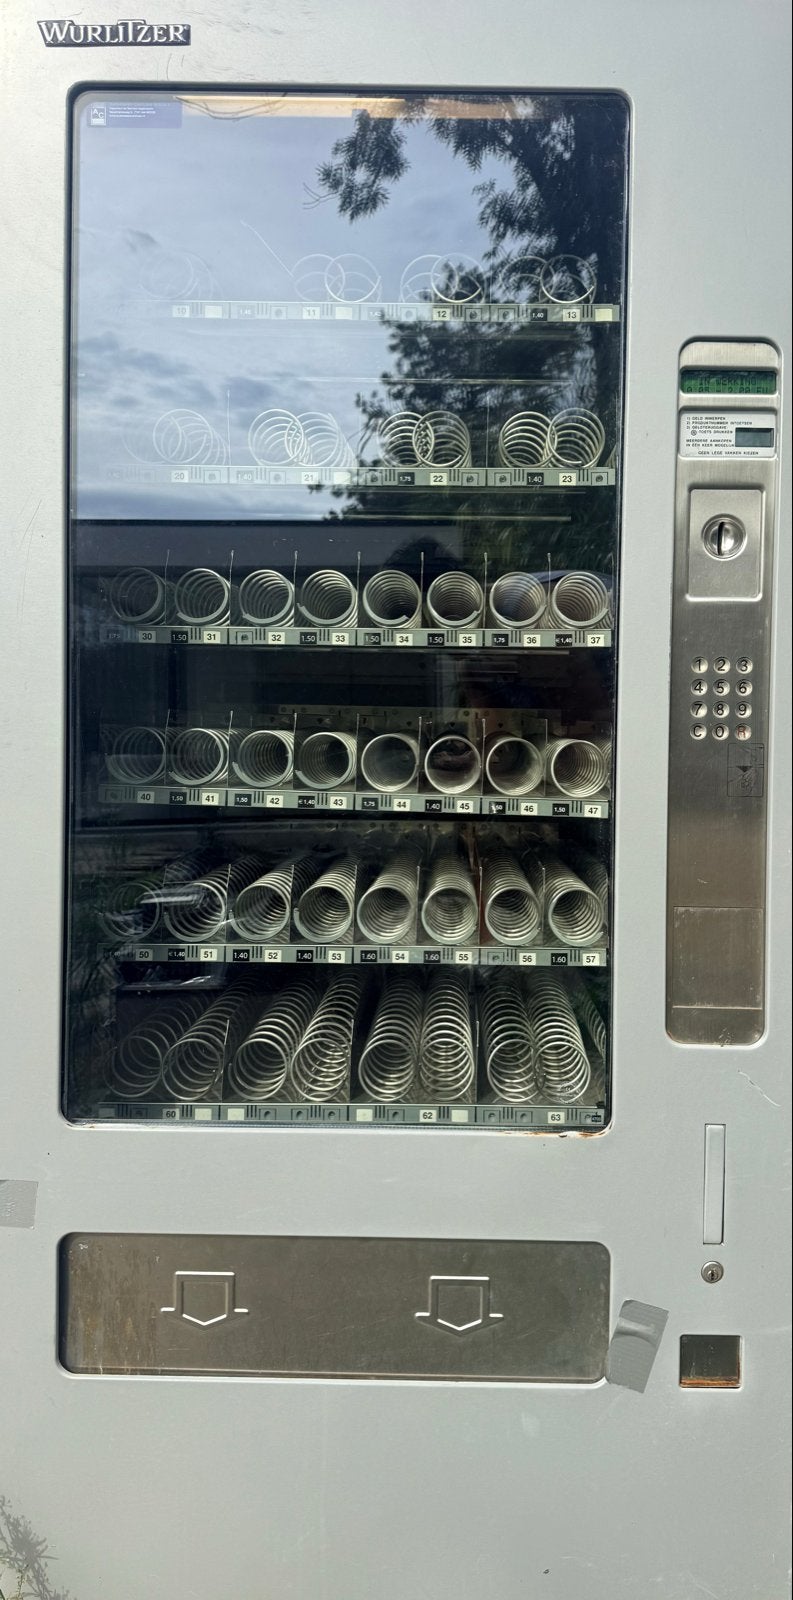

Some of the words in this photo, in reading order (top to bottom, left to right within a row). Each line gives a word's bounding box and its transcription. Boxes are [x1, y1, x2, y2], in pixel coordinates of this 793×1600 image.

[38, 21, 186, 43] WURLITZER
[696, 659, 701, 671] 1
[718, 660, 725, 672] 2
[740, 660, 748, 672] 3
[694, 682, 703, 693] 4
[717, 682, 724, 694] 5
[739, 682, 747, 694] 6
[694, 704, 702, 715] 7
[717, 704, 724, 716] 8
[738, 704, 746, 716] 9
[693, 726, 702, 738] C
[737, 727, 746, 738] R
